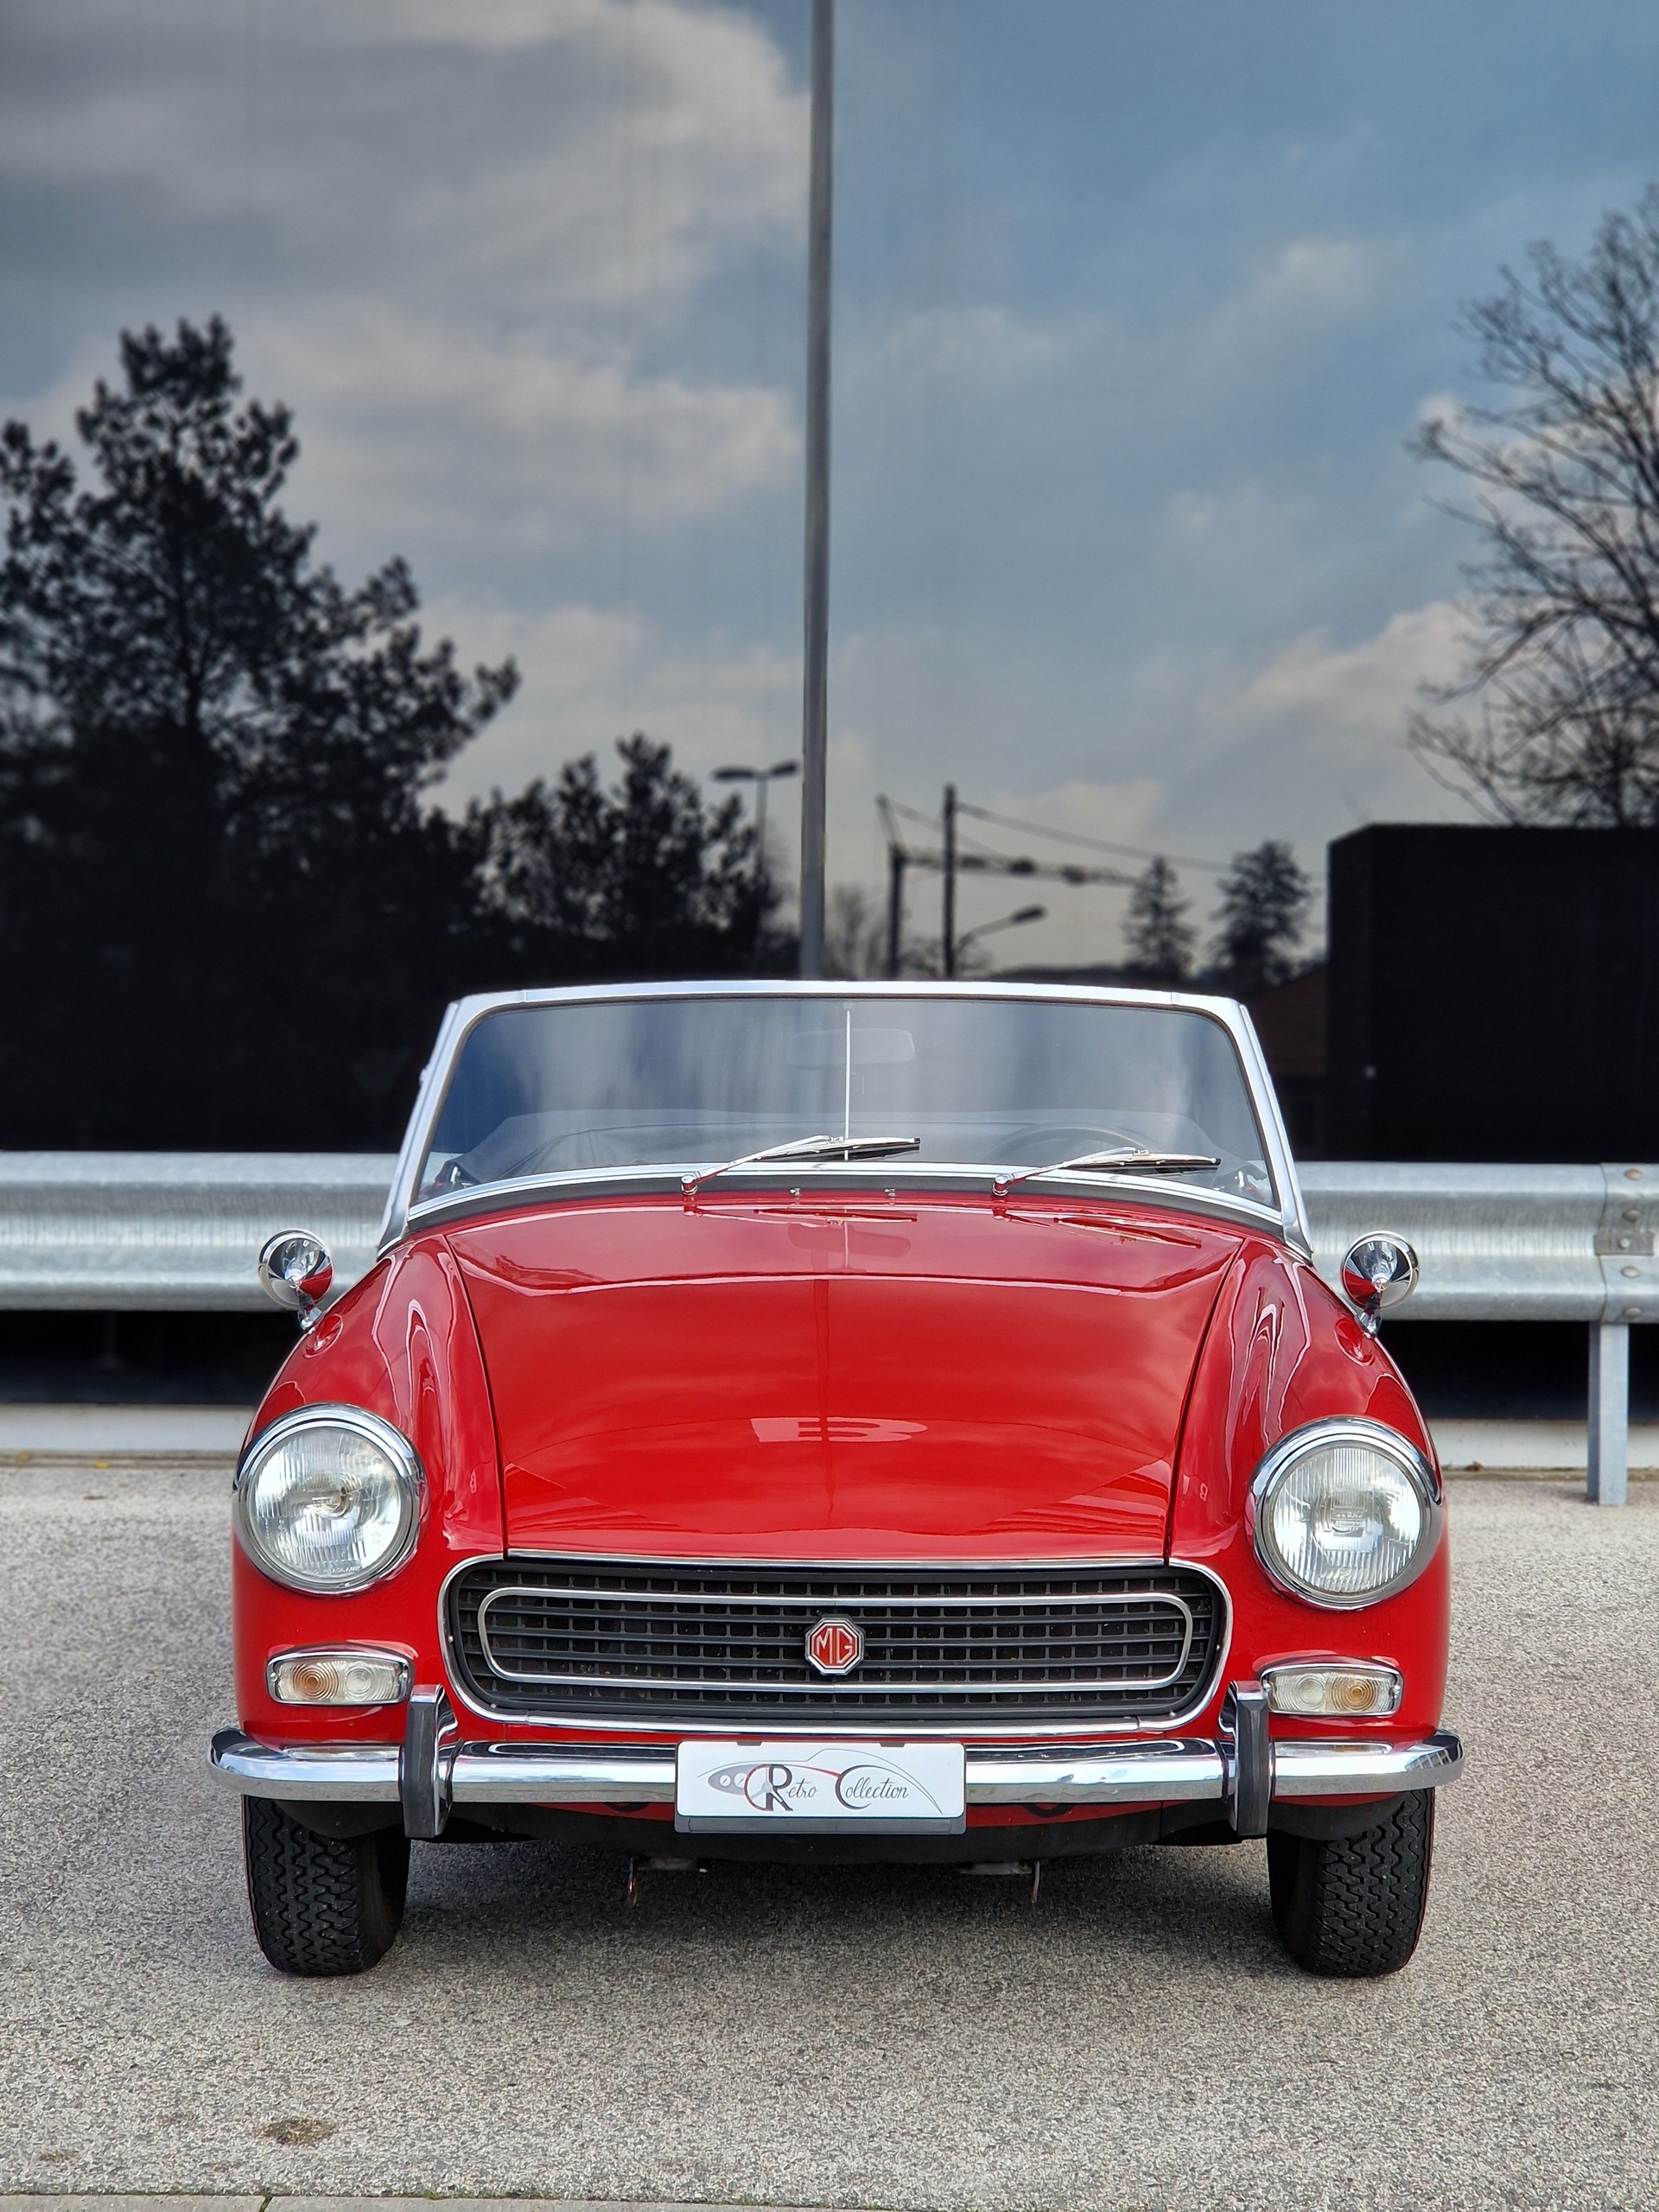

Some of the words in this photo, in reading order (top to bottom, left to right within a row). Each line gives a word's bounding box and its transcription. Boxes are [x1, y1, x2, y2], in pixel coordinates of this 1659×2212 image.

[816, 1627, 854, 1665] MG
[762, 1764, 818, 1812] Retro
[835, 1764, 910, 1810] Collection
